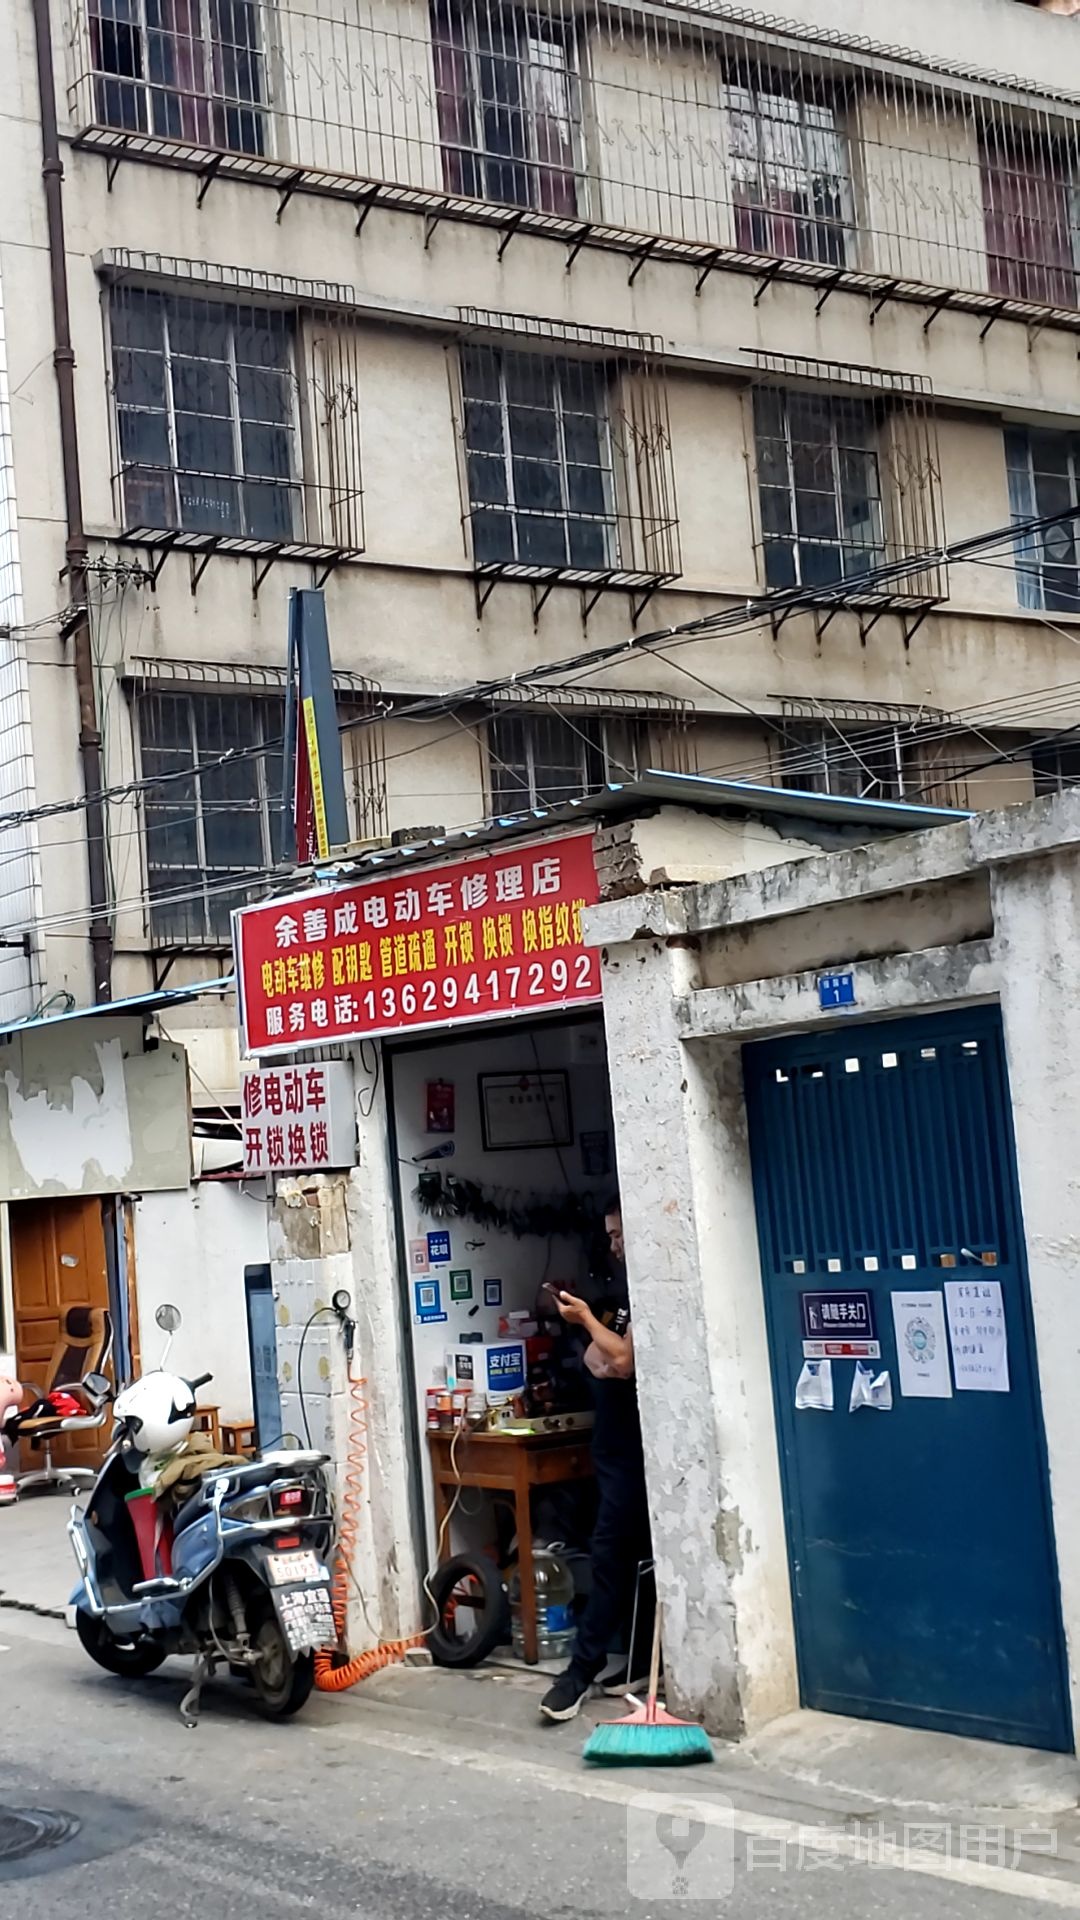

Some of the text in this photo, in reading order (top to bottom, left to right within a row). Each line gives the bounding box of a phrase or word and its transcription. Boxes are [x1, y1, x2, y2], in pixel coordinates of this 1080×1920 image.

[274, 858, 561, 948] 余善成电动车修理店
[261, 949, 325, 998] 电动车维修
[331, 941, 373, 987] 配钥匙
[380, 927, 437, 978] 管道疏通
[444, 920, 474, 967] 开锁
[482, 913, 514, 961] 换锁
[833, 989, 840, 1003] 1
[243, 1067, 326, 1118] 修电动车
[245, 1121, 329, 1167] 开锁换锁
[489, 1352, 521, 1368] 支付宝
